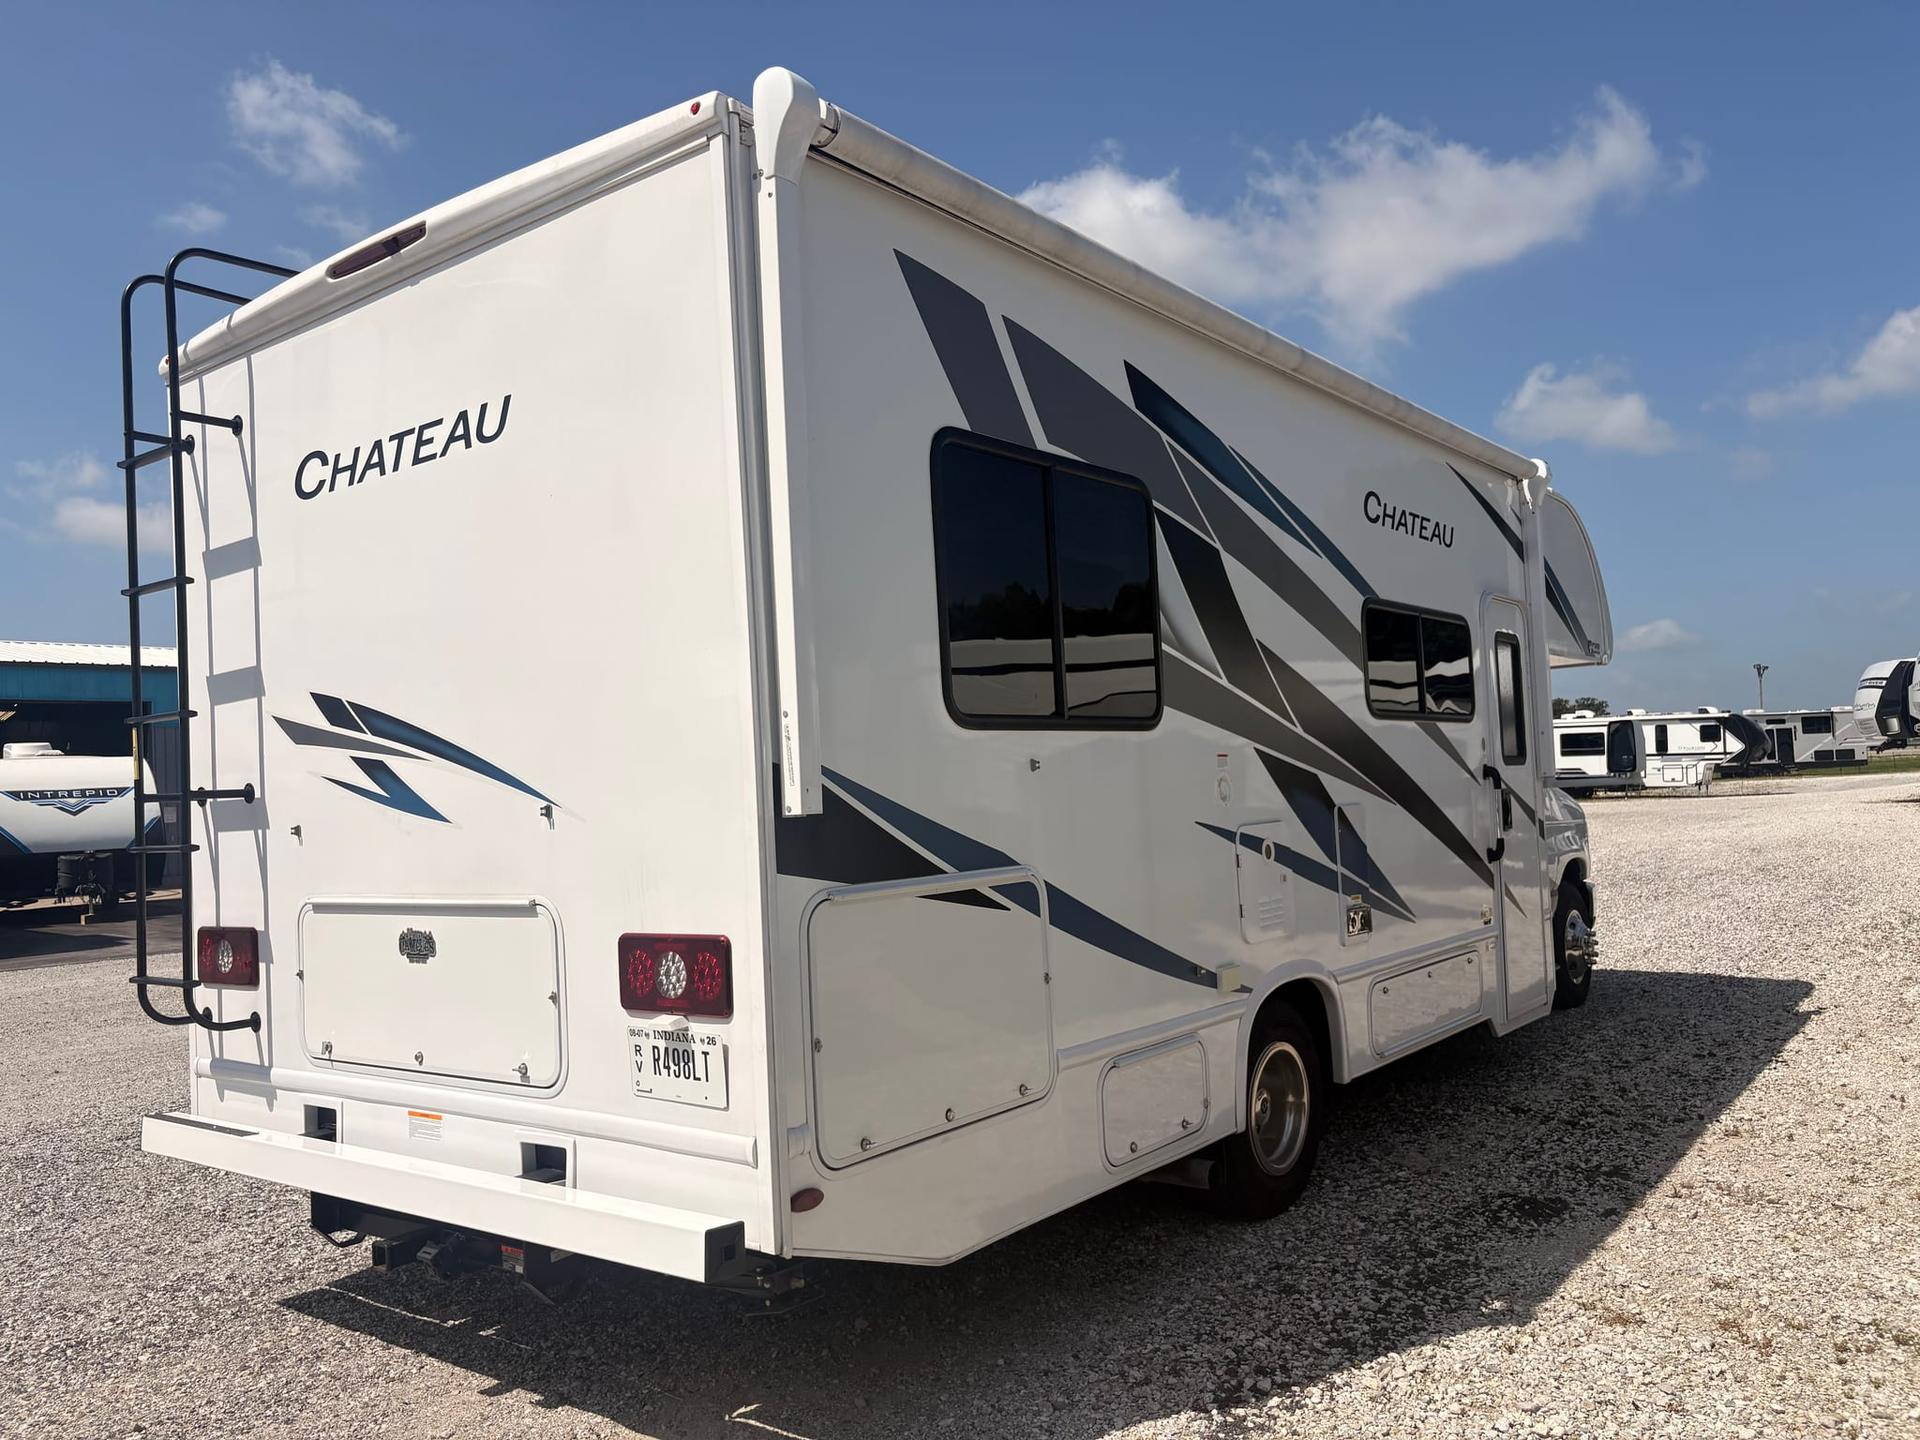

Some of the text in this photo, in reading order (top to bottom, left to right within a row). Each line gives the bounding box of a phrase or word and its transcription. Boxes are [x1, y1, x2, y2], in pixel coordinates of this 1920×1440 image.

[294, 393, 512, 501] CHATEAU
[1363, 490, 1454, 548] CHATEAU
[20, 788, 118, 799] INTREPID
[652, 1029, 696, 1044] INDIANA
[705, 1035, 717, 1046] 26
[651, 1045, 710, 1083] R498LT
